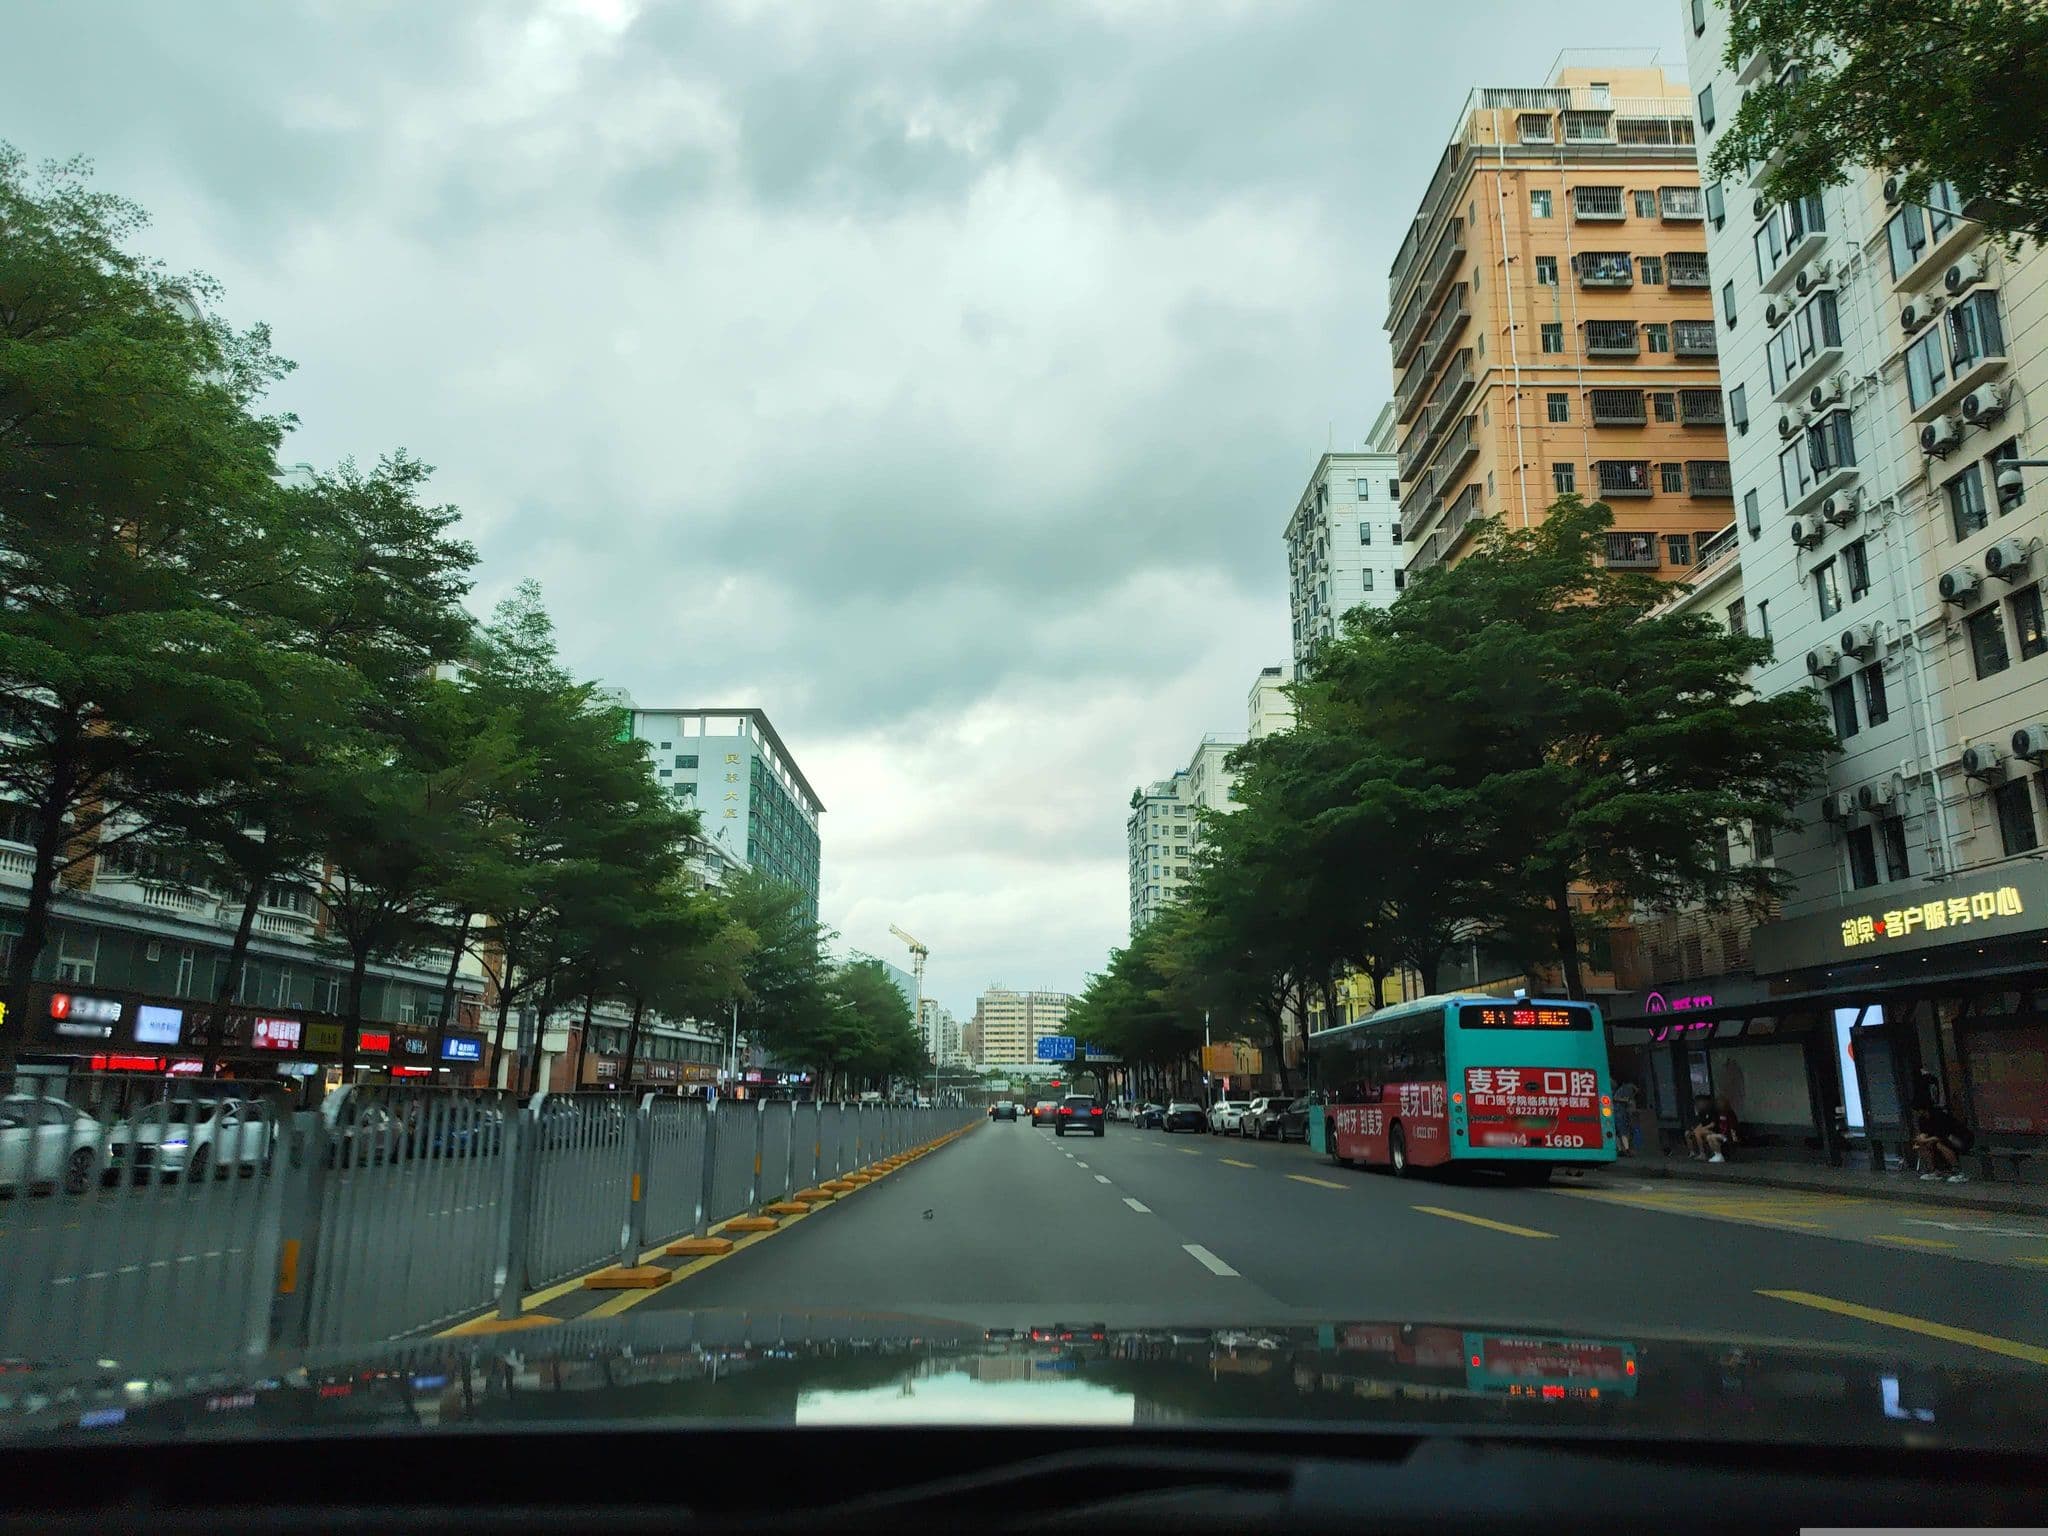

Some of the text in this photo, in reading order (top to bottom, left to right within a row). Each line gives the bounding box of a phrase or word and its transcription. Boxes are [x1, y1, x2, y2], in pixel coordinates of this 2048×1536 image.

[1883, 886, 2023, 938] 客户服务中心
[1468, 1069, 1596, 1097] 麦芽 口腔
[1400, 1083, 1444, 1118] 麦芽口腔
[1545, 1135, 1584, 1147] 168D
